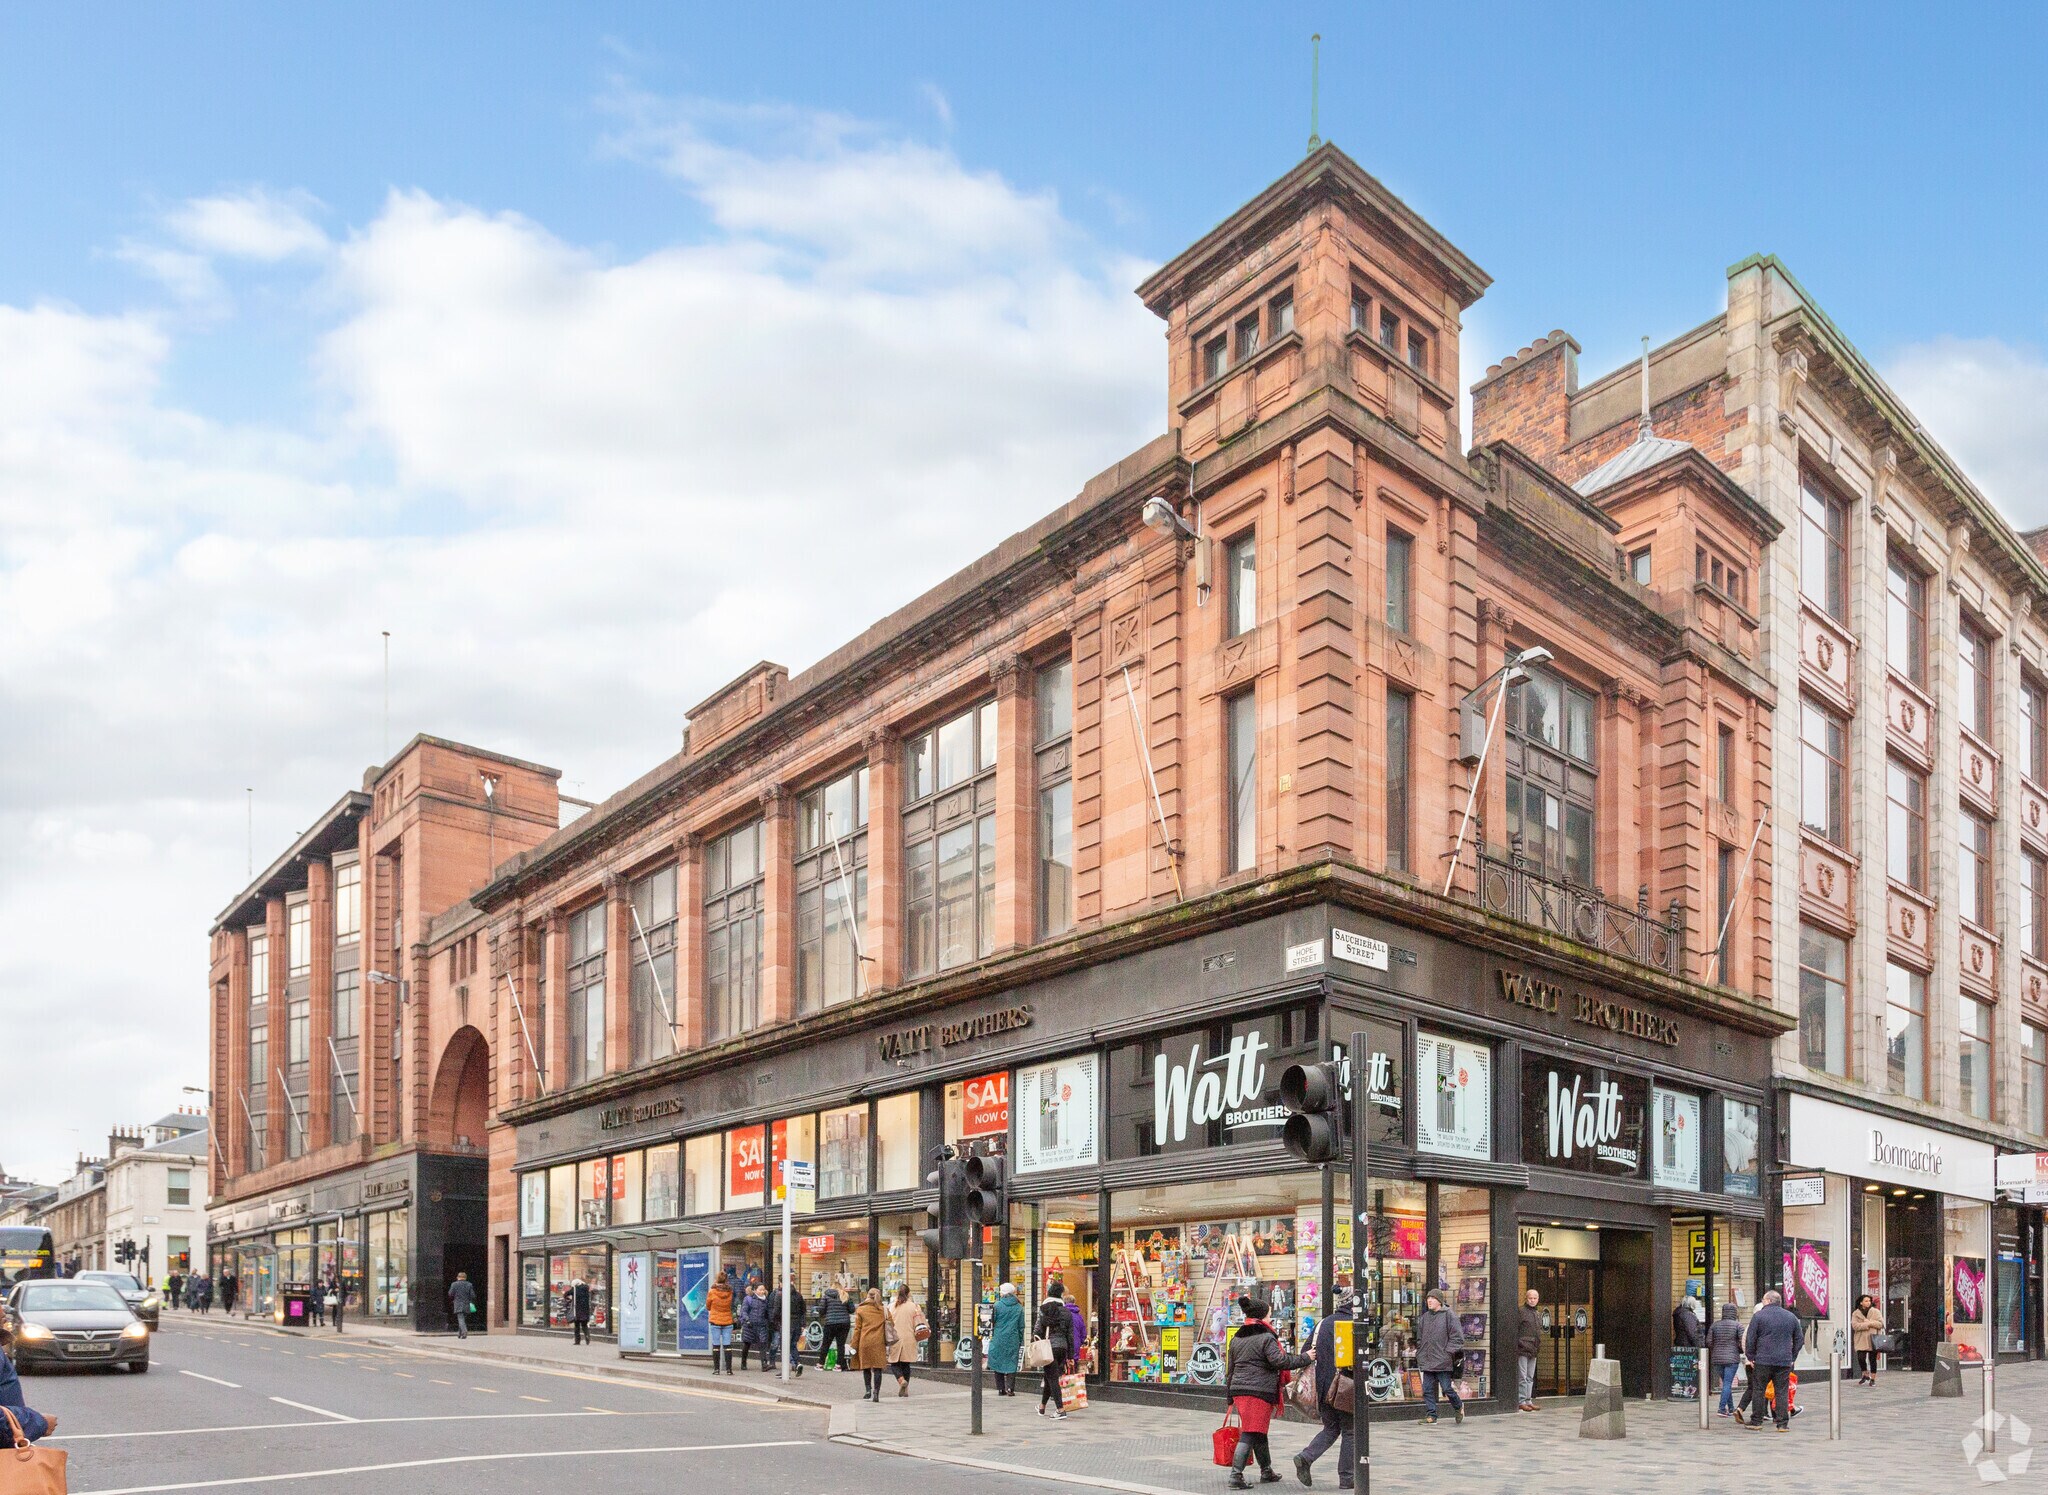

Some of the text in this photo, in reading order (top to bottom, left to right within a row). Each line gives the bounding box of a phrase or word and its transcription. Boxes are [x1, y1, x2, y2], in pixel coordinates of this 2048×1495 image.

[1296, 945, 1314, 957] HOPE
[1335, 930, 1386, 953] SAUCHIEHALL
[1346, 944, 1375, 960] STREET
[1292, 954, 1317, 967] STREET
[1500, 969, 1680, 1046] WATT BROTHERS
[878, 1004, 1034, 1061] WATT BROTHERS
[1333, 1045, 1391, 1101] Wtt
[966, 1077, 1008, 1110] SAL
[1155, 1031, 1269, 1146] Watt
[975, 1110, 1008, 1125] NOW O
[1225, 1104, 1293, 1126] BROTHERS
[1549, 1071, 1623, 1159] Watt
[1598, 1145, 1637, 1161] BROTHERS
[1873, 1129, 1943, 1175] Bonmarché
[745, 1170, 761, 1182] NOW
[807, 1237, 826, 1249] SALE
[1519, 1228, 1545, 1253] Watt
[1803, 1253, 1828, 1296] MEGA
[1801, 1267, 1826, 1307] DEALS
[1165, 1334, 1177, 1342] TOYS
